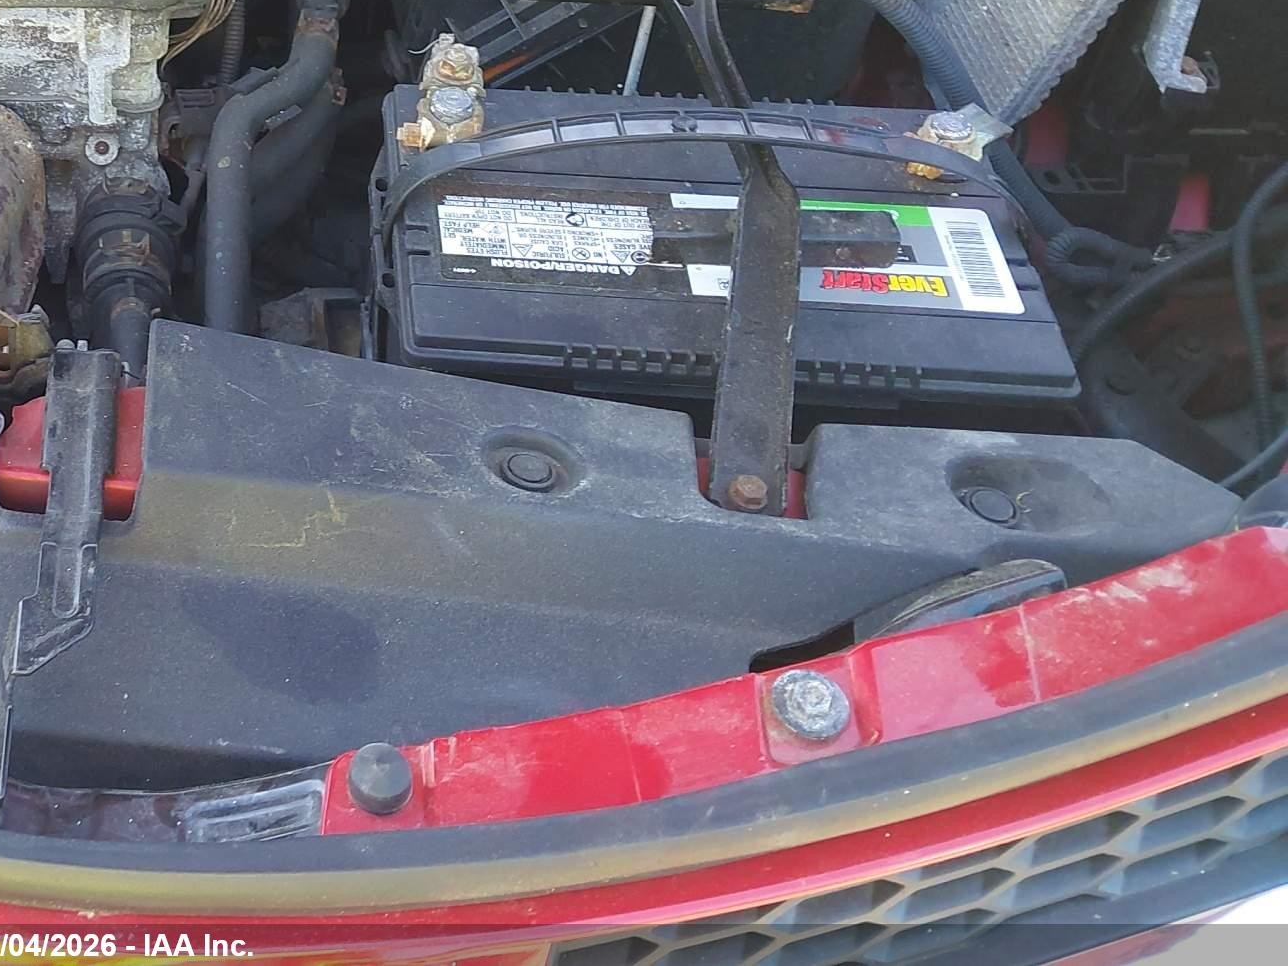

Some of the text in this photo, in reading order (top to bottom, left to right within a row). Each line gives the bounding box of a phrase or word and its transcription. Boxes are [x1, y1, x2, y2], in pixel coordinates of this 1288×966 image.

[460, 241, 507, 249] IMMEDIATELY
[532, 251, 566, 259] SULFURIC
[491, 258, 621, 275] DANGER/POISON
[822, 269, 949, 297] EverStart
